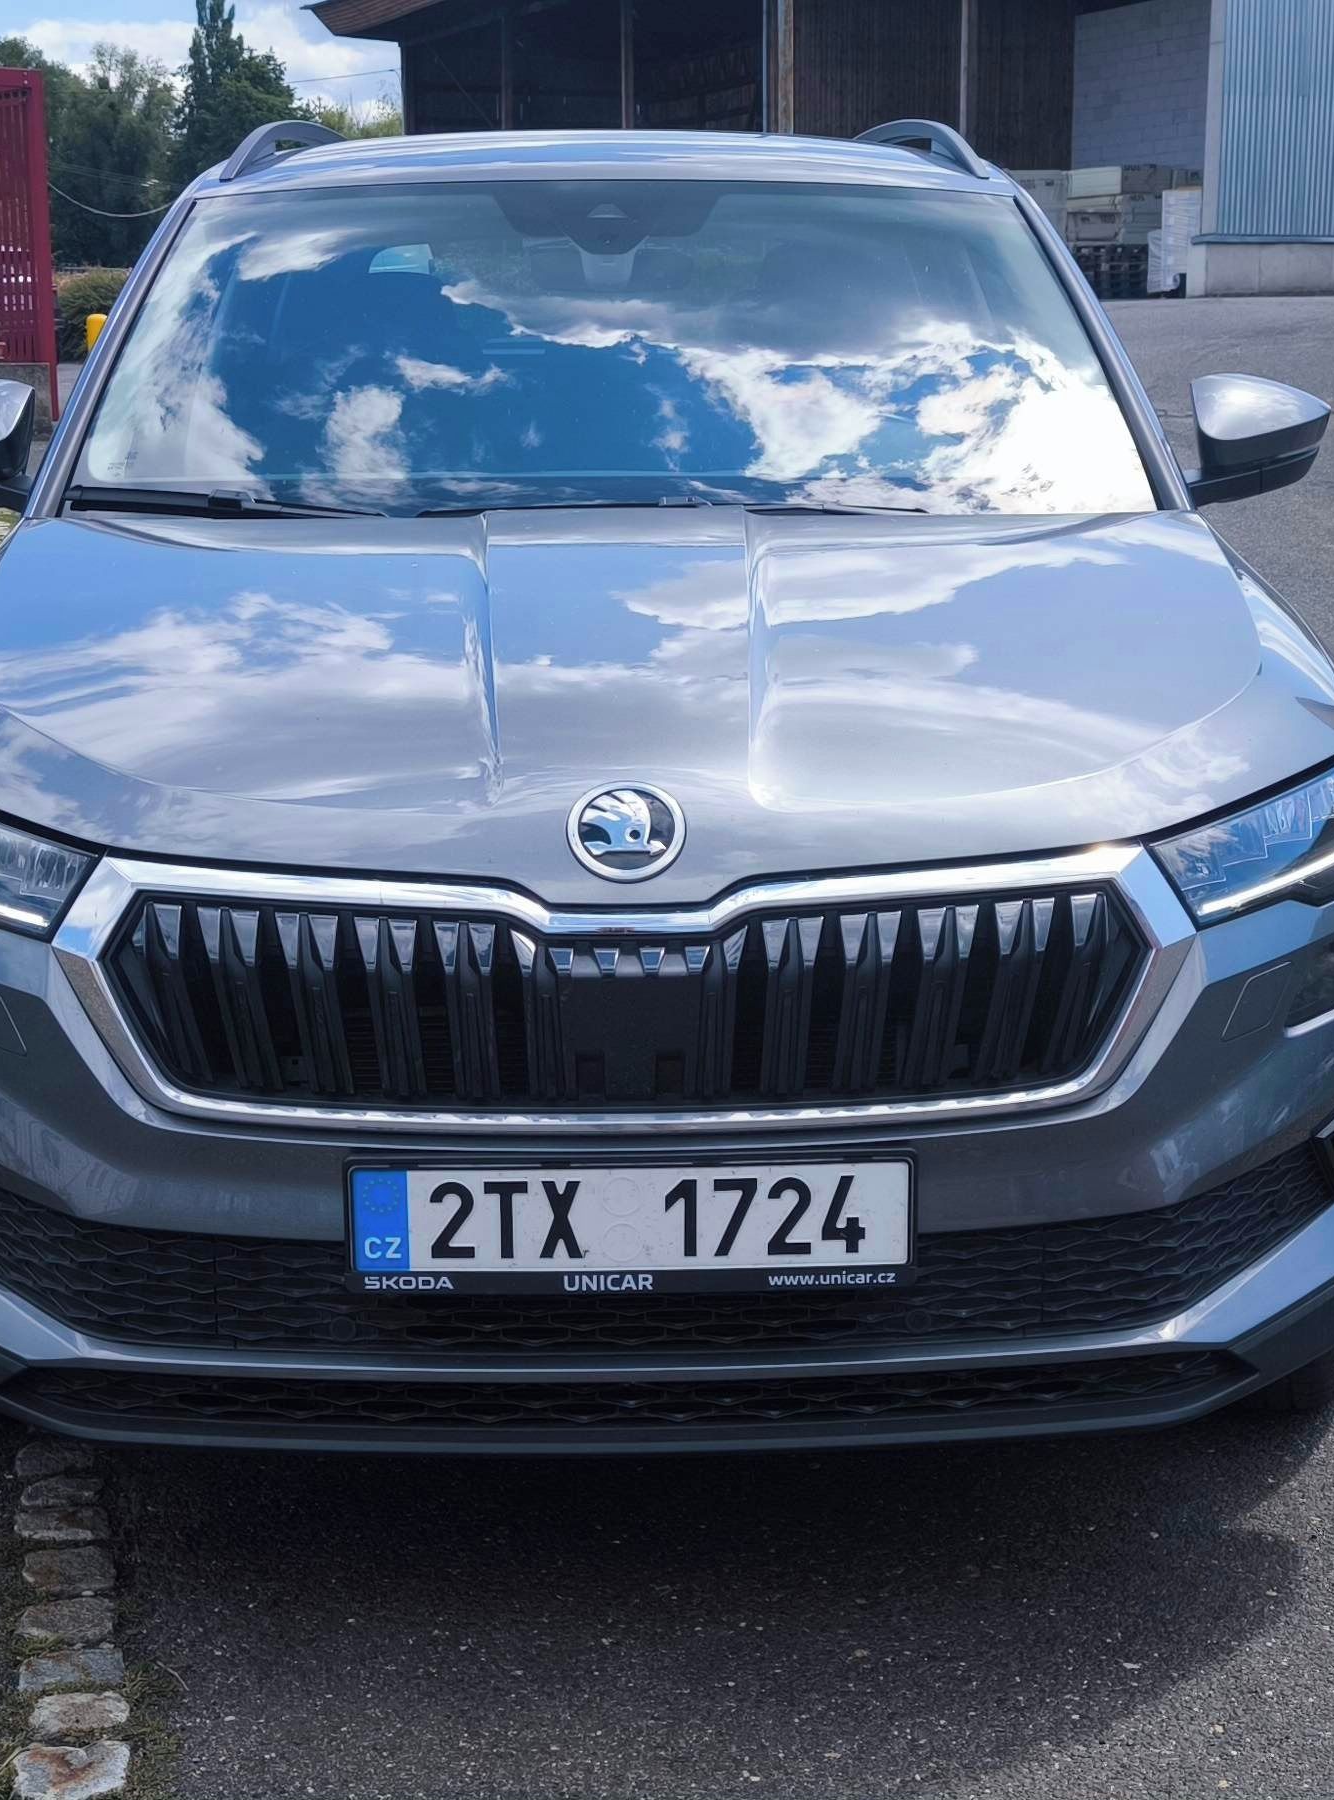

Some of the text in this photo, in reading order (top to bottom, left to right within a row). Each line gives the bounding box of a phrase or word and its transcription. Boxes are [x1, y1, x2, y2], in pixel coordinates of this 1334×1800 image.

[429, 1175, 865, 1259] 2TX 1724
[364, 1236, 402, 1259] CZ
[563, 1274, 653, 1292] UNICAR
[768, 1271, 896, 1286] www.unicar.cz
